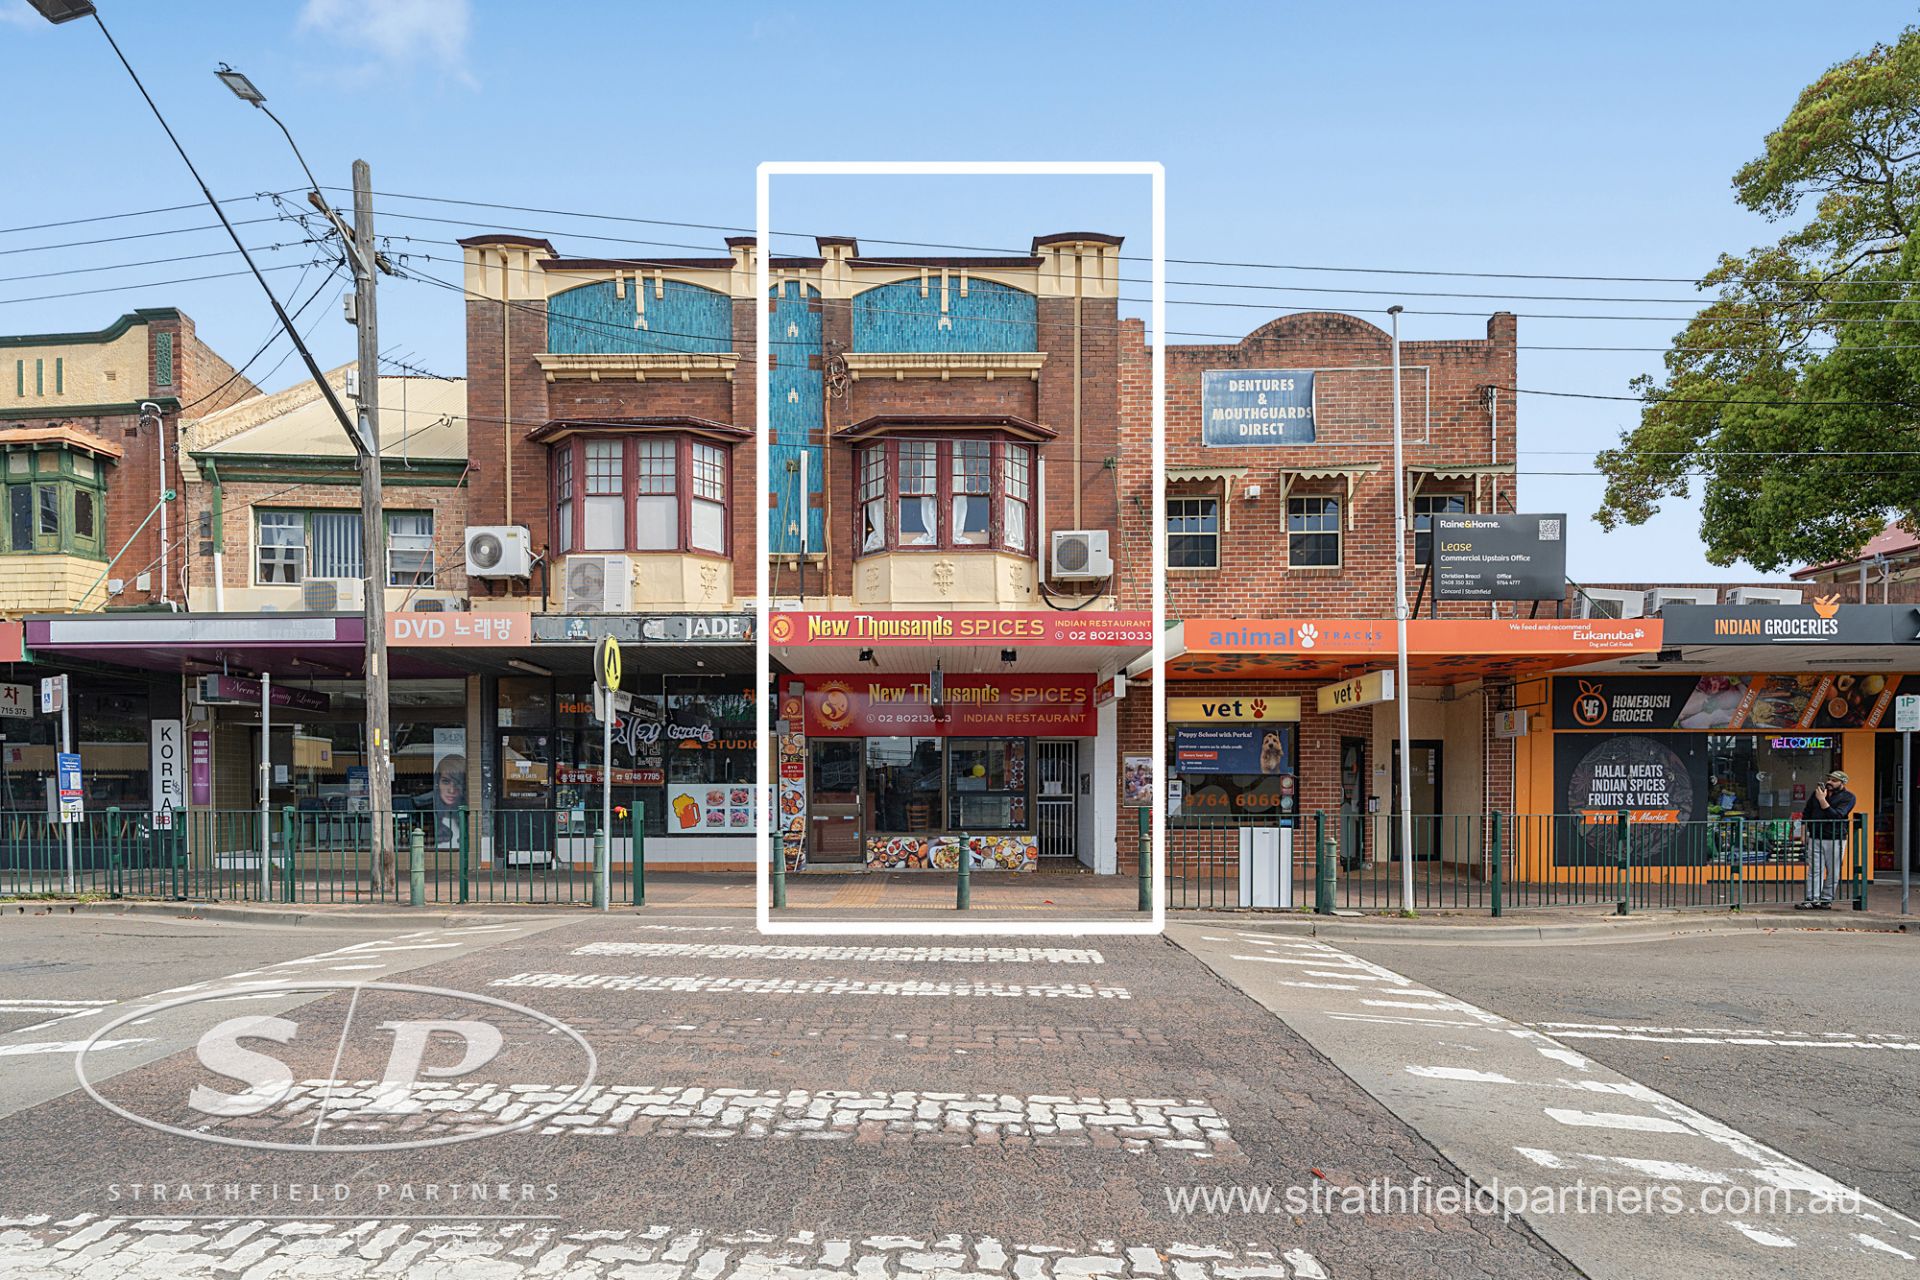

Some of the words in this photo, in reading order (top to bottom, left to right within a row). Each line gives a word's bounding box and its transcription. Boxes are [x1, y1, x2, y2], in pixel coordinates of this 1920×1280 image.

[1229, 379, 1294, 392] DENTURES
[1257, 393, 1267, 405] &
[1212, 406, 1313, 420] MOUTHGUARDS
[1239, 422, 1284, 436] DIRECT
[1441, 541, 1472, 552] Lease
[1440, 554, 1481, 562] Commercial
[1482, 554, 1509, 563] Upstairs
[1510, 554, 1531, 562] Office
[395, 619, 445, 639] DVD
[454, 618, 512, 640] 노래방
[685, 618, 741, 639] JADE
[808, 615, 850, 642] New
[854, 615, 953, 642] Thousands
[960, 619, 1045, 635] SPICES
[1714, 619, 1761, 635] INDIAN
[1764, 618, 1838, 635] GROCERIES
[1069, 631, 1086, 640] 02
[1090, 631, 1152, 640] 80213033
[1208, 627, 1294, 646] animal
[1322, 631, 1383, 640] TRACKS
[1573, 631, 1634, 640] Eukanuba
[4, 686, 20, 705] 차
[868, 683, 906, 708] New
[910, 683, 1000, 708] Thusands
[1010, 687, 1087, 702] SPICES
[1333, 684, 1352, 704] vet
[560, 702, 592, 714] Hello
[1612, 695, 1671, 708] HOMEBUSH
[1801, 705, 1815, 728] INDIAN
[1811, 677, 1832, 709] GROCERIES
[1901, 697, 1916, 707] 1P
[1, 707, 13, 715] 715
[14, 707, 27, 716] 375
[1201, 700, 1243, 718] vet
[1868, 707, 1882, 728] FRESH
[1878, 689, 1892, 709] FOODS
[878, 714, 893, 723] 02
[963, 714, 1003, 723] INDIAN
[1006, 714, 1086, 723] RESTAURANT
[1612, 709, 1653, 722] GROCER
[1178, 731, 1198, 739] Puppy
[161, 727, 174, 812] KOREA
[1594, 765, 1627, 777] HALAL
[1629, 765, 1663, 777] MEATS
[1592, 779, 1627, 791] INDIAN
[1630, 779, 1665, 791] SPICES
[1235, 793, 1281, 807] 6066
[1588, 793, 1623, 806] FRUITS
[1626, 793, 1634, 805] &
[1637, 793, 1669, 805] VEGES
[1638, 811, 1669, 821] Market
